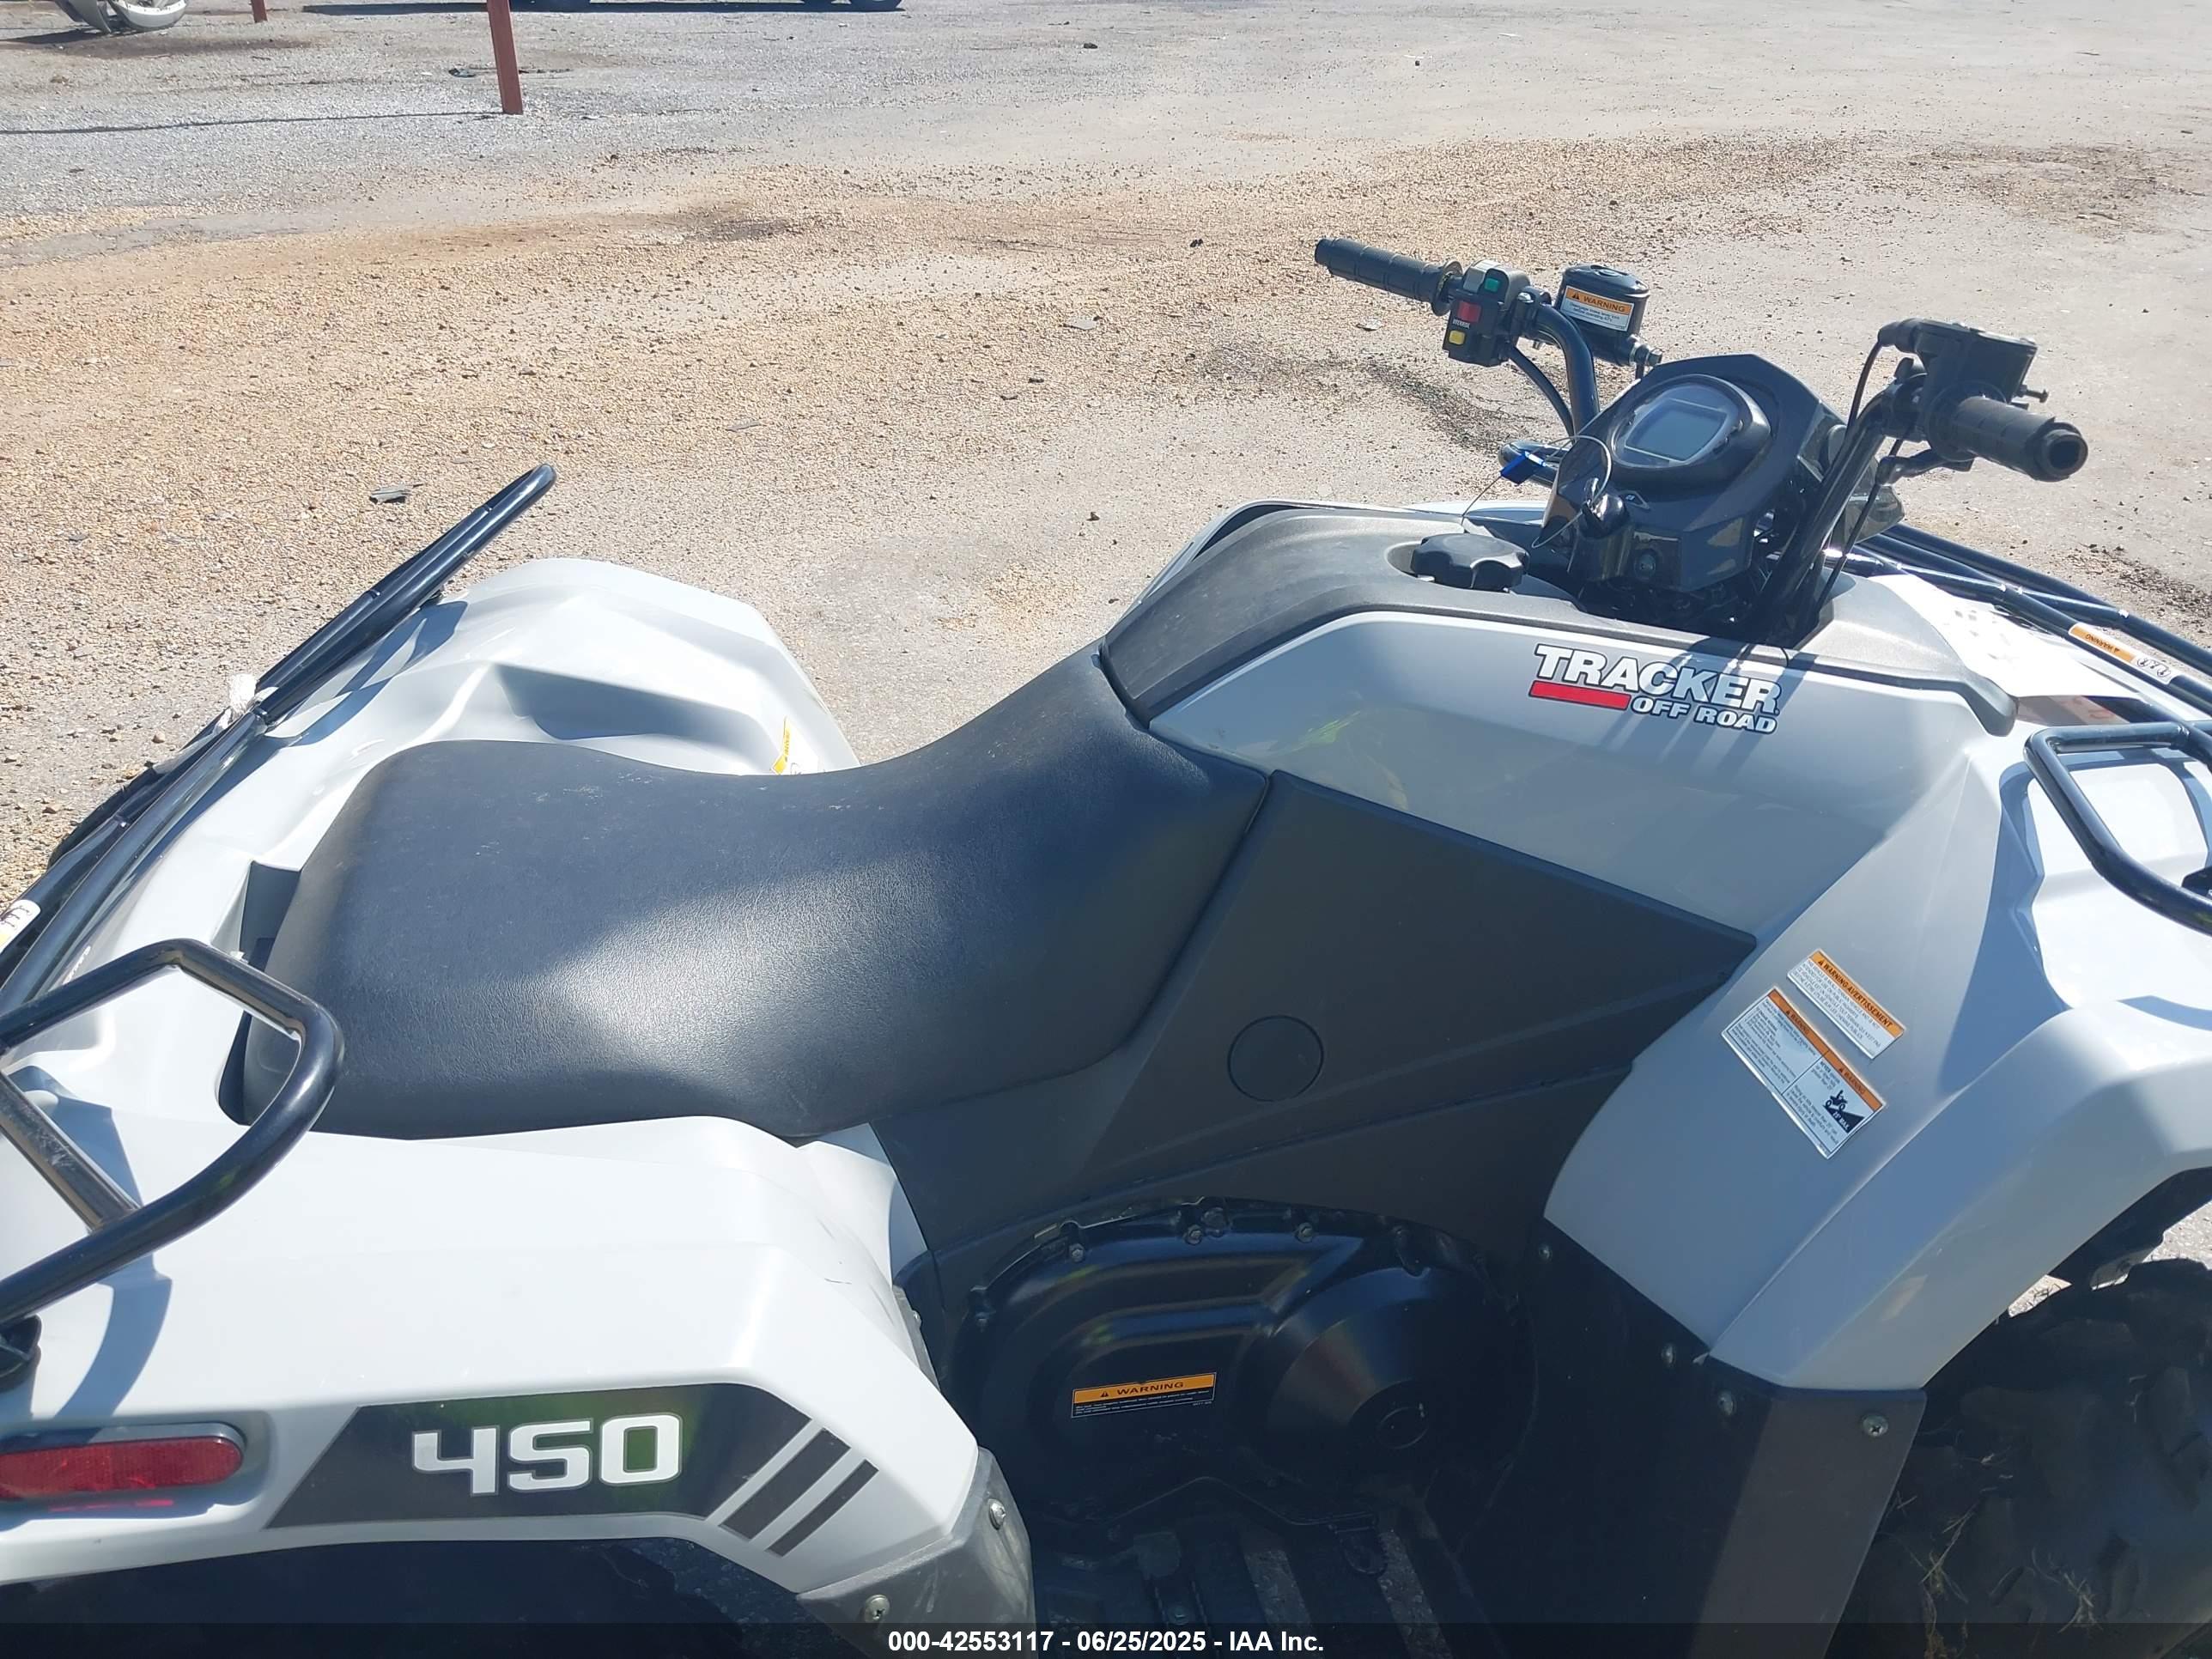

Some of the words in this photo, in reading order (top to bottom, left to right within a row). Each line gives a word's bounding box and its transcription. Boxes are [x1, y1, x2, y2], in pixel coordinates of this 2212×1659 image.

[1583, 295, 1625, 313] WARNING
[1534, 644, 1783, 714] TRACKER
[1632, 696, 1690, 719] OFF
[1694, 707, 1778, 734] ROAD
[1824, 963, 1849, 988] WARNING
[1848, 986, 1893, 1028] AVERTISSEMENT
[1116, 1381, 1185, 1396] WARNING
[410, 1412, 683, 1497] 450
